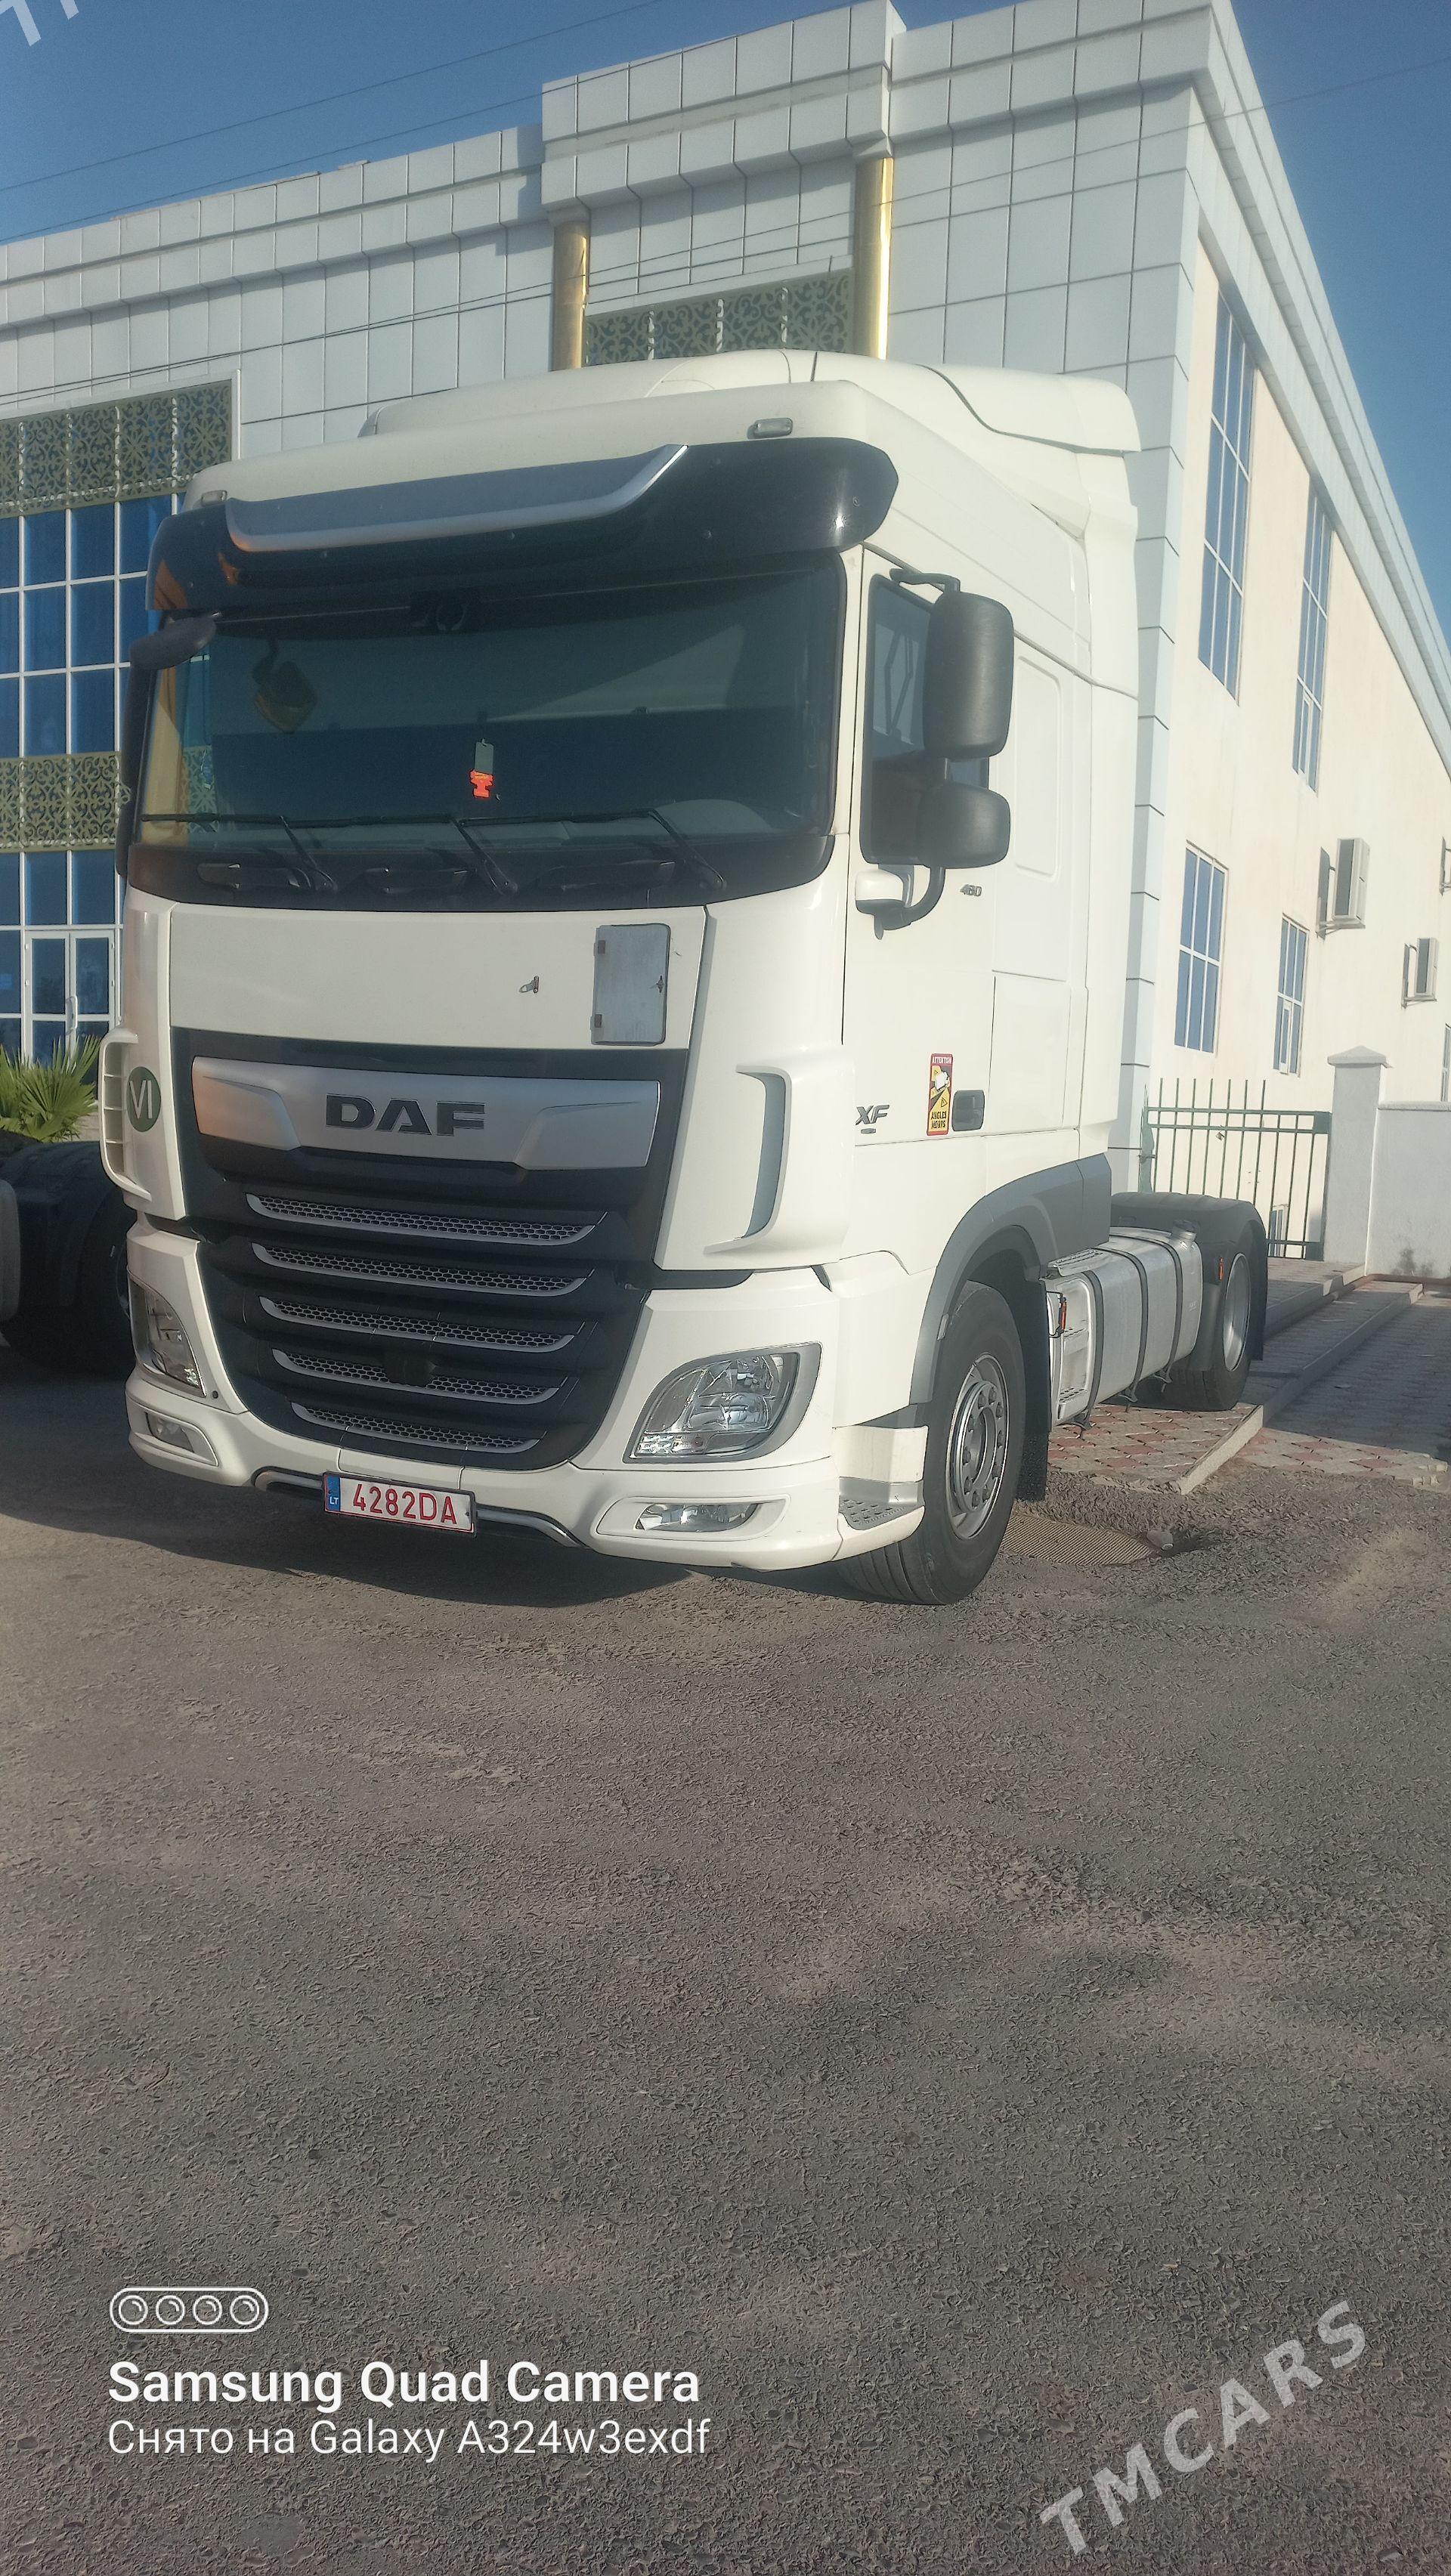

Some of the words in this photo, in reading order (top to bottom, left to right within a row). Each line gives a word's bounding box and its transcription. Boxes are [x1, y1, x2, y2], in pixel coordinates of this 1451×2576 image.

[129, 1080, 153, 1119] VI
[326, 1094, 485, 1136] DAF
[855, 1104, 890, 1126] XF
[329, 1497, 339, 1505] LT
[352, 1483, 457, 1525] 4282DA
